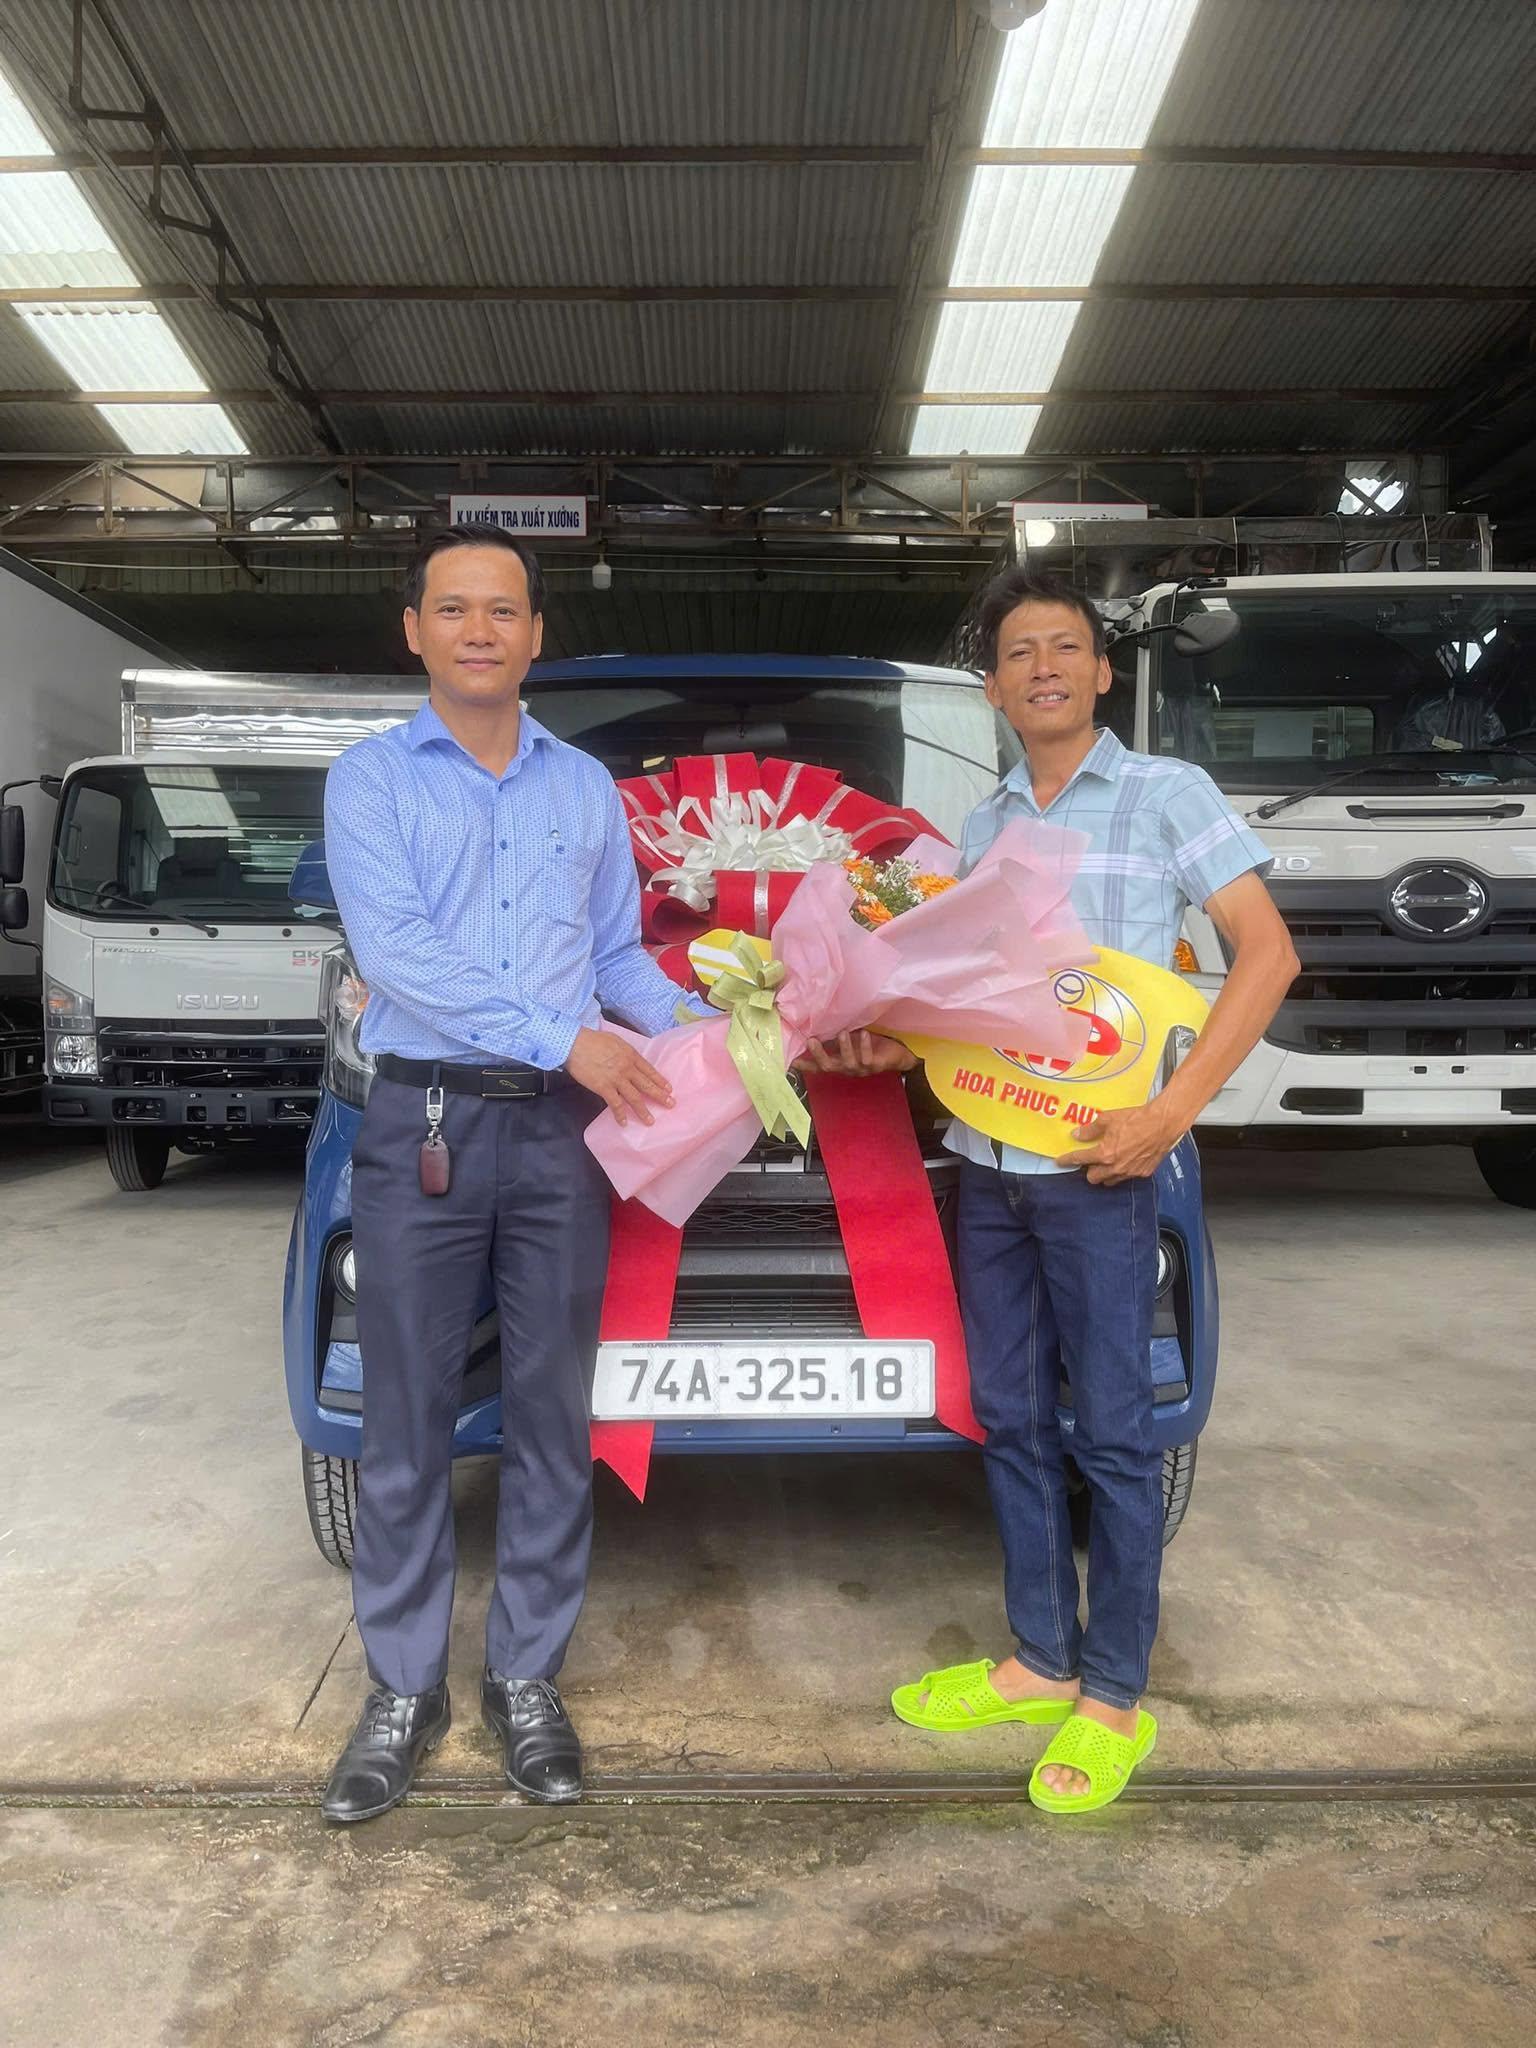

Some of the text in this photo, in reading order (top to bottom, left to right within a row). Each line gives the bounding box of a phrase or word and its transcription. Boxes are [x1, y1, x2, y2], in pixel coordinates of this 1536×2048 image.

[501, 510, 519, 527] TRA
[521, 504, 545, 527] XUẤT
[547, 505, 580, 528] XƯỞNG
[176, 993, 260, 1011] ISUZU
[953, 1068, 996, 1099] HOA
[1000, 1081, 1060, 1117] PHUC
[621, 1357, 903, 1402] 74A-325.18
